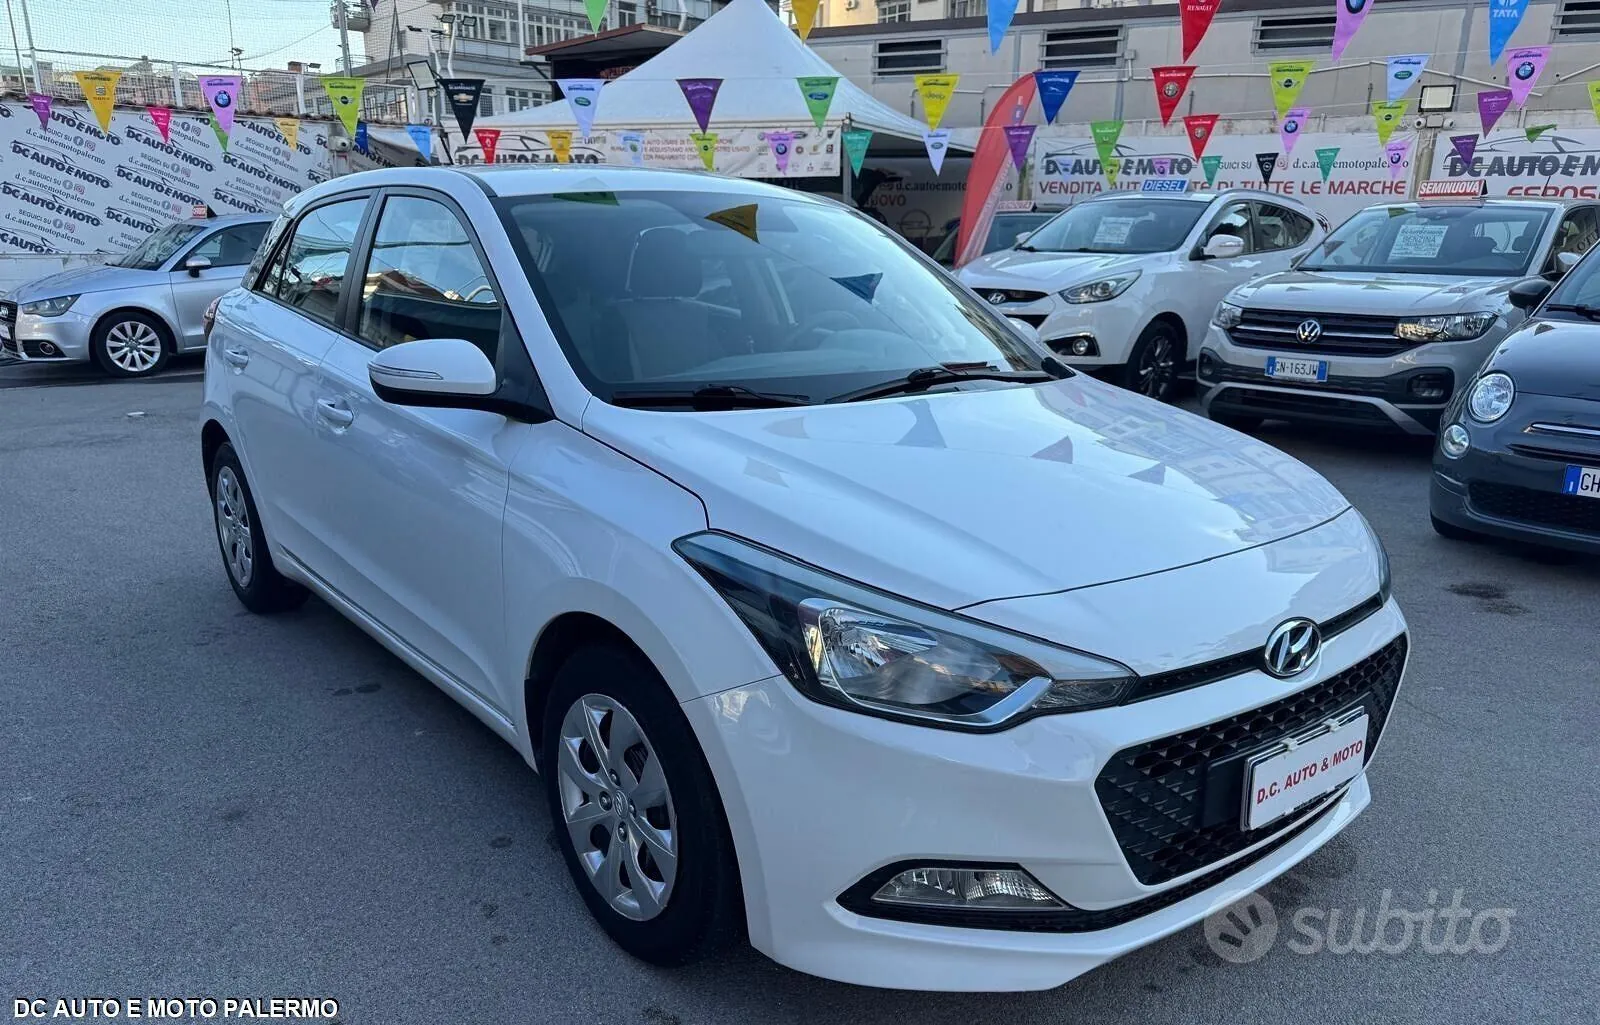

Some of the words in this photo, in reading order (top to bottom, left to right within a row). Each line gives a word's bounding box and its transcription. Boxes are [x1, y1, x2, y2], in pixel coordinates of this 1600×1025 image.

[1493, 9, 1518, 18] TATA
[1039, 181, 1102, 195] VENDITA
[1301, 181, 1321, 195] LE
[1328, 181, 1407, 195] MARCHE
[1144, 180, 1182, 192] DIESEL
[1419, 181, 1480, 194] SEMINUOVA
[1256, 782, 1281, 804] D.C.
[1284, 762, 1317, 791] AUTO
[1320, 757, 1329, 772] &
[1332, 739, 1363, 767] MOTO
